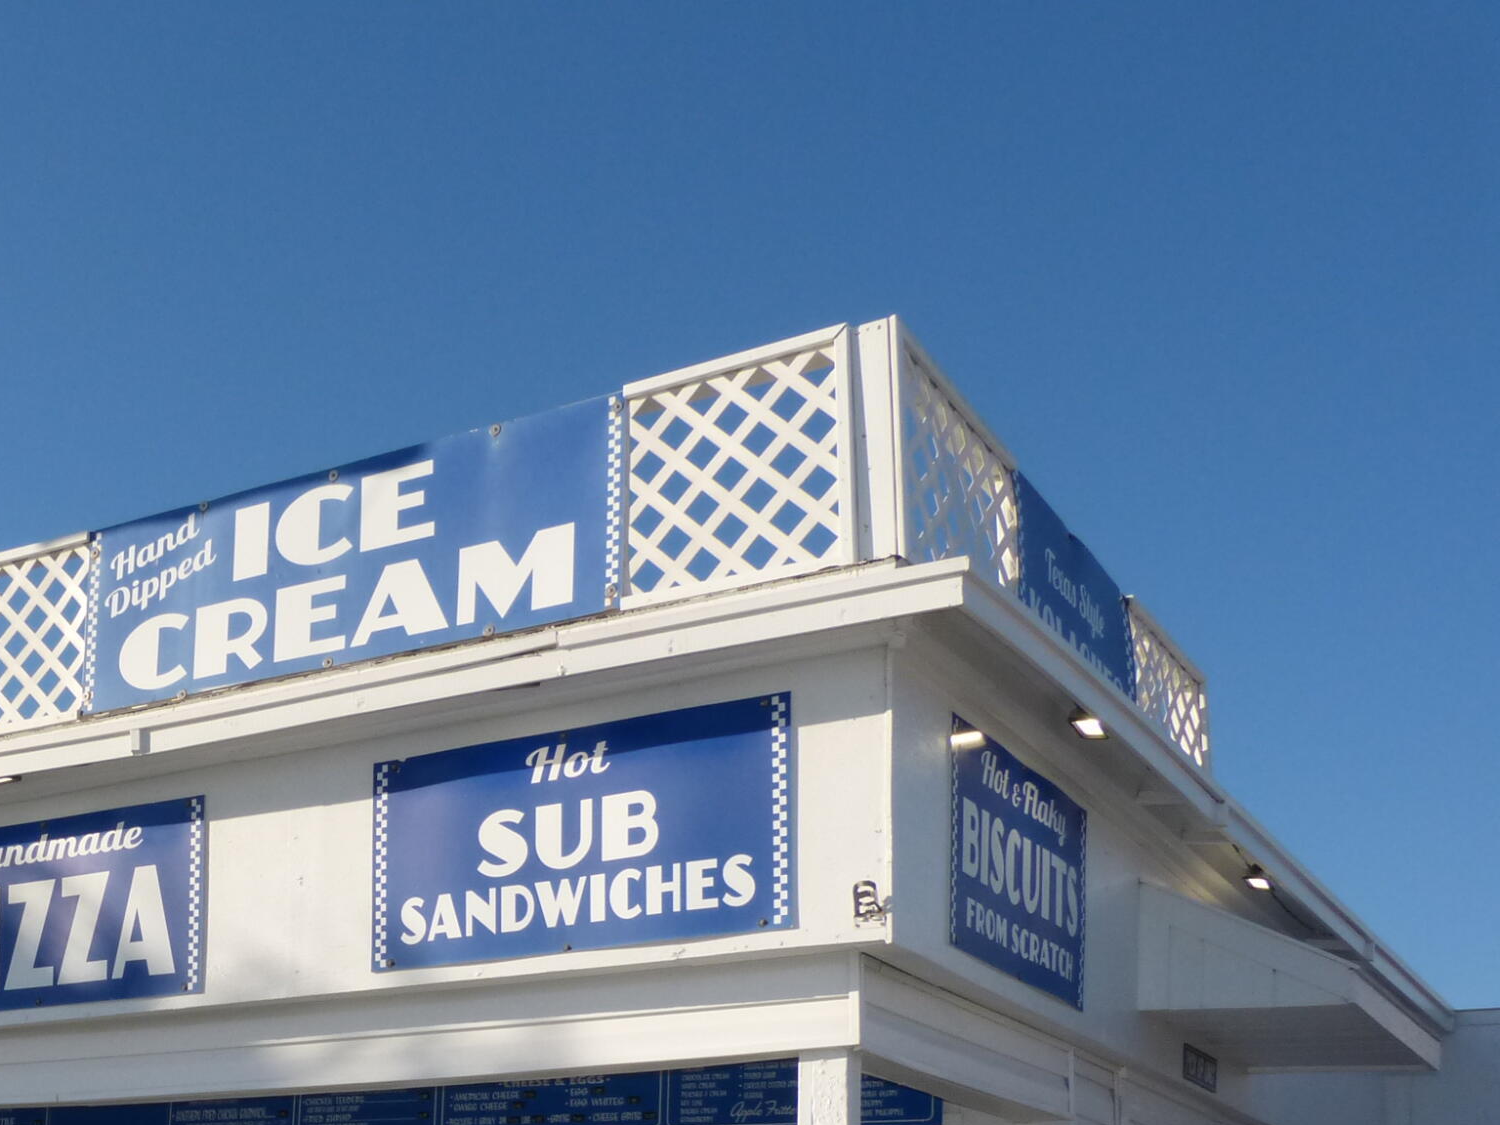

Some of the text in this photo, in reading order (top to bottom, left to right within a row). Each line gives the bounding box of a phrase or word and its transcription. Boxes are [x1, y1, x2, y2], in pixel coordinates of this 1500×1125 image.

[109, 512, 202, 583] Hand
[232, 459, 436, 583] ICE
[103, 538, 218, 619] Dipped
[118, 521, 576, 691] CREAM
[1044, 547, 1106, 640] Texas Style
[524, 740, 611, 785] Hot
[980, 750, 1068, 847] Hot & Flaky
[476, 789, 660, 879] SUB
[961, 796, 1079, 938] BISCUITS
[399, 853, 757, 946] SANDWICHES
[965, 896, 1074, 982] FROM SCRATCH
[729, 1100, 764, 1124] Apple
